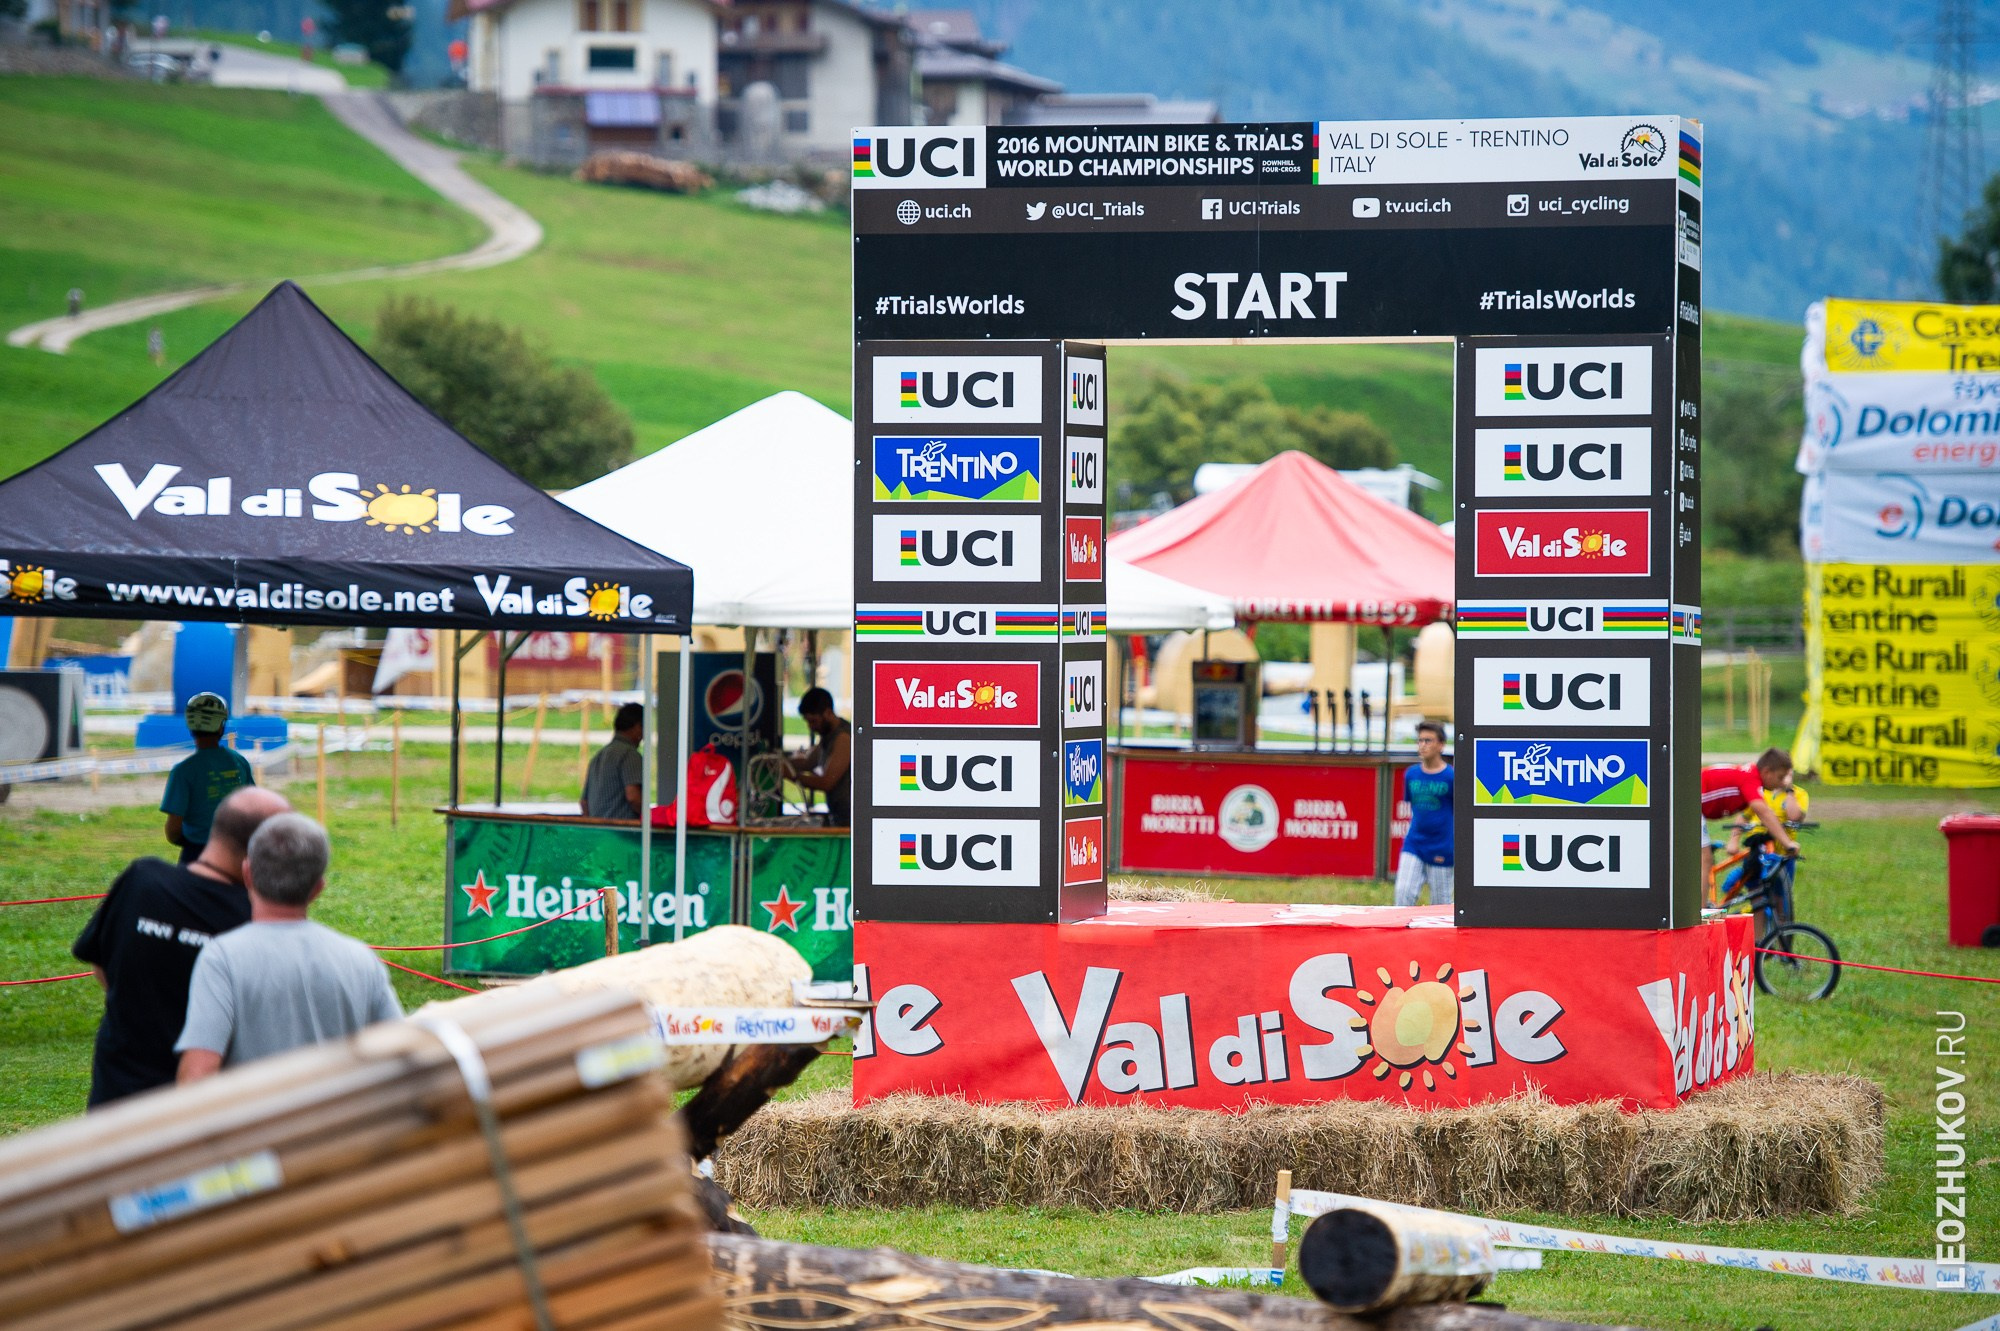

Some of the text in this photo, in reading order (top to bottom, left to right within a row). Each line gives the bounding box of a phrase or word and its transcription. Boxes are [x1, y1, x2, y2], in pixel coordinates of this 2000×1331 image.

[997, 133, 1304, 154] 2016 MOUNTAIN BIKE & TRIALS
[1329, 133, 1364, 150] VAL
[1370, 132, 1390, 149] DI
[1396, 132, 1448, 149] SOLE
[1470, 129, 1569, 148] TRENTINO
[876, 137, 974, 177] UCI
[997, 156, 1254, 177] WORLD CHAMPIONSHIPS
[1329, 156, 1376, 173] ITALY
[1578, 152, 1660, 171] Val di Sole
[925, 204, 972, 219] uci.ch
[1052, 200, 1145, 220] @UCI_Trials
[1385, 197, 1452, 214] tv.uci.ch
[1538, 195, 1630, 215] uci_cycling
[875, 294, 1025, 316] #TrialsWorlds
[1171, 272, 1348, 321] START
[1479, 287, 1636, 311] #TrialsWorlds
[922, 371, 1014, 409] UCI
[1077, 373, 1098, 410] UCI
[1527, 362, 1623, 400] UCI
[896, 448, 1018, 483] TRENTINO
[1076, 452, 1097, 489] UCI
[1526, 443, 1622, 481] UCI
[93, 462, 516, 537] Val di Sole
[921, 530, 1013, 567] UCI
[1498, 526, 1627, 560] Val di Sole
[106, 581, 455, 614] www.valdisole.net
[472, 574, 654, 622] Val di Sole
[1873, 568, 1967, 599] Rurali
[926, 611, 987, 635] UCI
[1075, 611, 1090, 636] UCI
[1530, 607, 1594, 632] UCI
[1875, 640, 1968, 673] Rurali
[895, 677, 1018, 711] Val di Sole
[1075, 675, 1096, 713] UCI
[1525, 673, 1621, 710] UCI
[921, 755, 1013, 792] UCI
[1498, 751, 1625, 786] TRENTINO
[1151, 795, 1204, 815] BIRRA
[1293, 799, 1347, 821] BIRRA
[1141, 814, 1215, 835] MORETTI
[1284, 818, 1358, 840] MORETTI
[921, 834, 1013, 871] UCI
[1525, 834, 1621, 873] UCI
[1010, 952, 1569, 1105] Val di Sole
